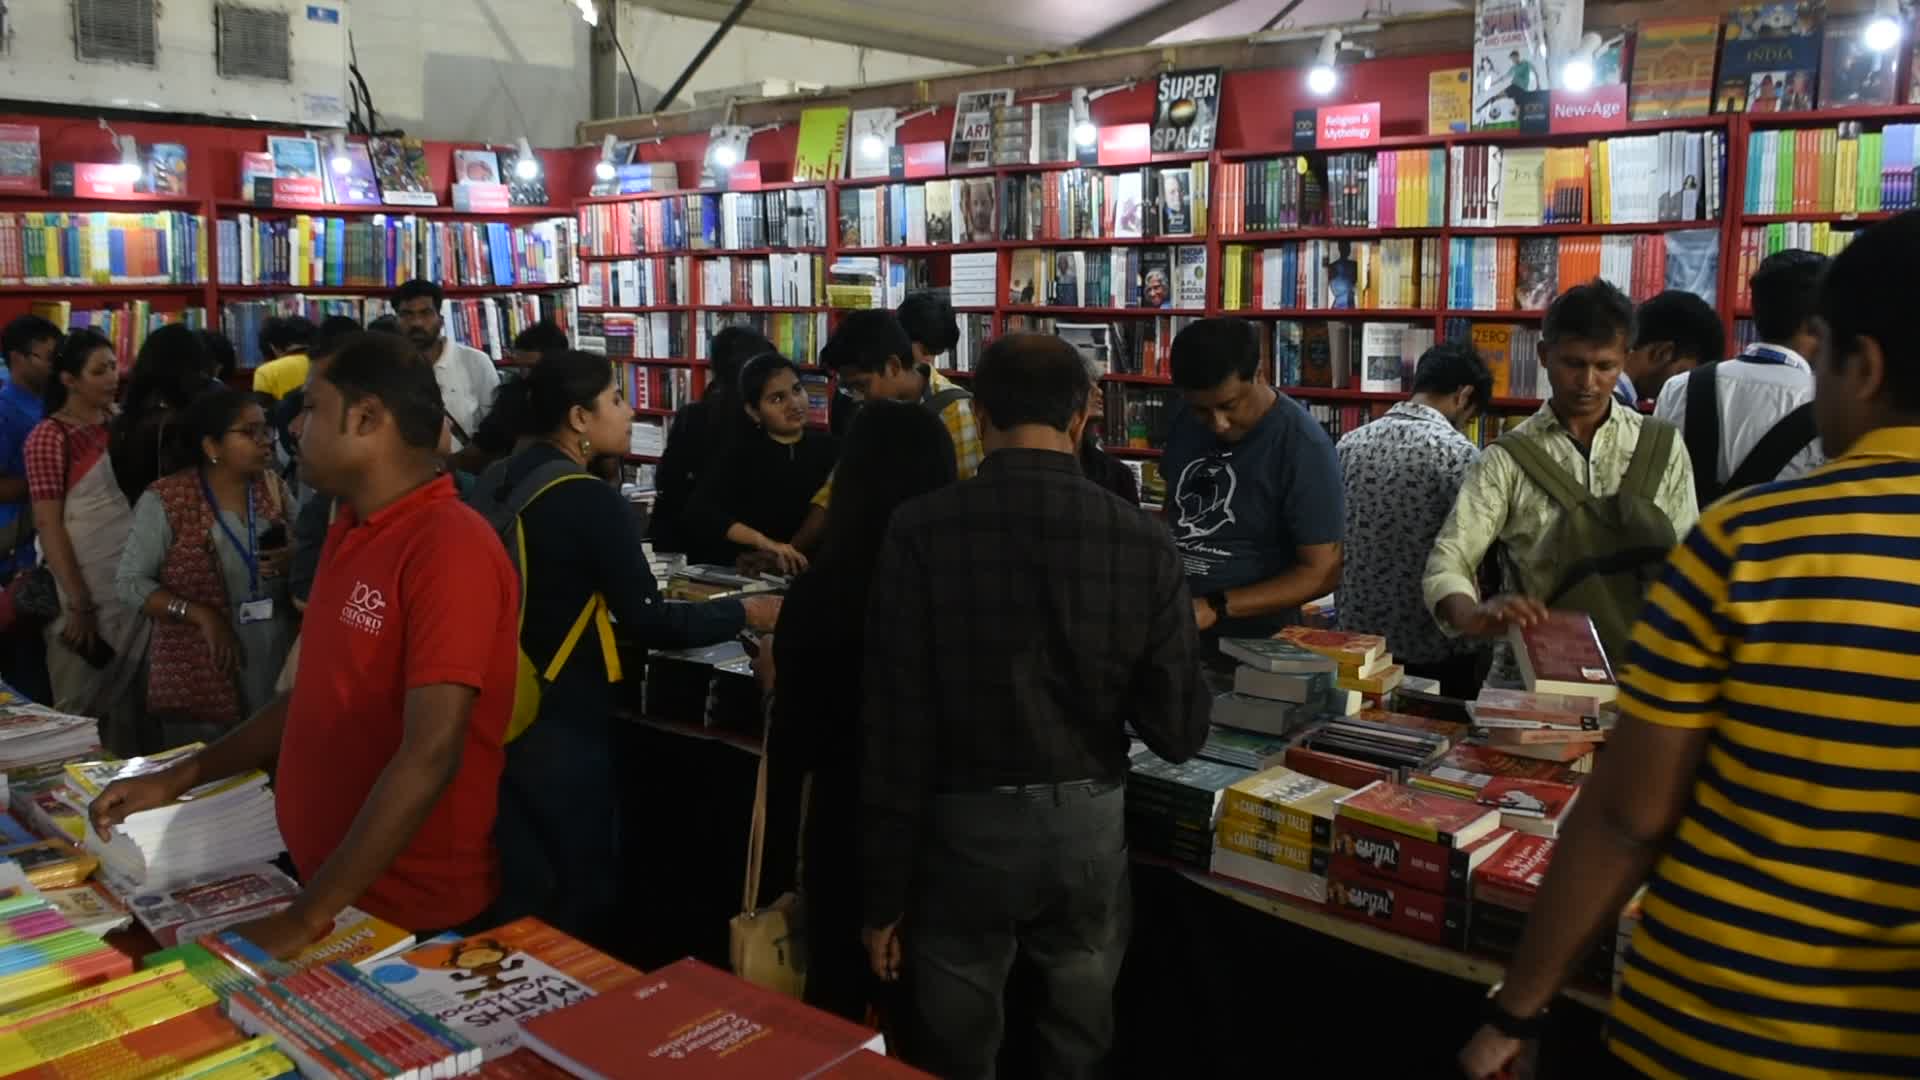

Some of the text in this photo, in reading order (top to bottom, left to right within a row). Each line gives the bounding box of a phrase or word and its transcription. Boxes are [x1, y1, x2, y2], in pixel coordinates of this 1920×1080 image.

[1747, 47, 1793, 61] INDIA
[1158, 74, 1217, 101] SUPER
[1555, 101, 1621, 118] New-Age
[1325, 114, 1361, 128] Religion
[965, 124, 991, 139] ART
[1152, 123, 1211, 151] SPACE
[1324, 127, 1371, 140] Mythology
[1473, 328, 1508, 343] ZERO
[1287, 813, 1310, 834] TALES
[1284, 846, 1309, 866] TALES
[1355, 838, 1397, 868] CAPITAL
[1349, 887, 1392, 917] CAPITAL
[464, 980, 581, 1029] MATHS
